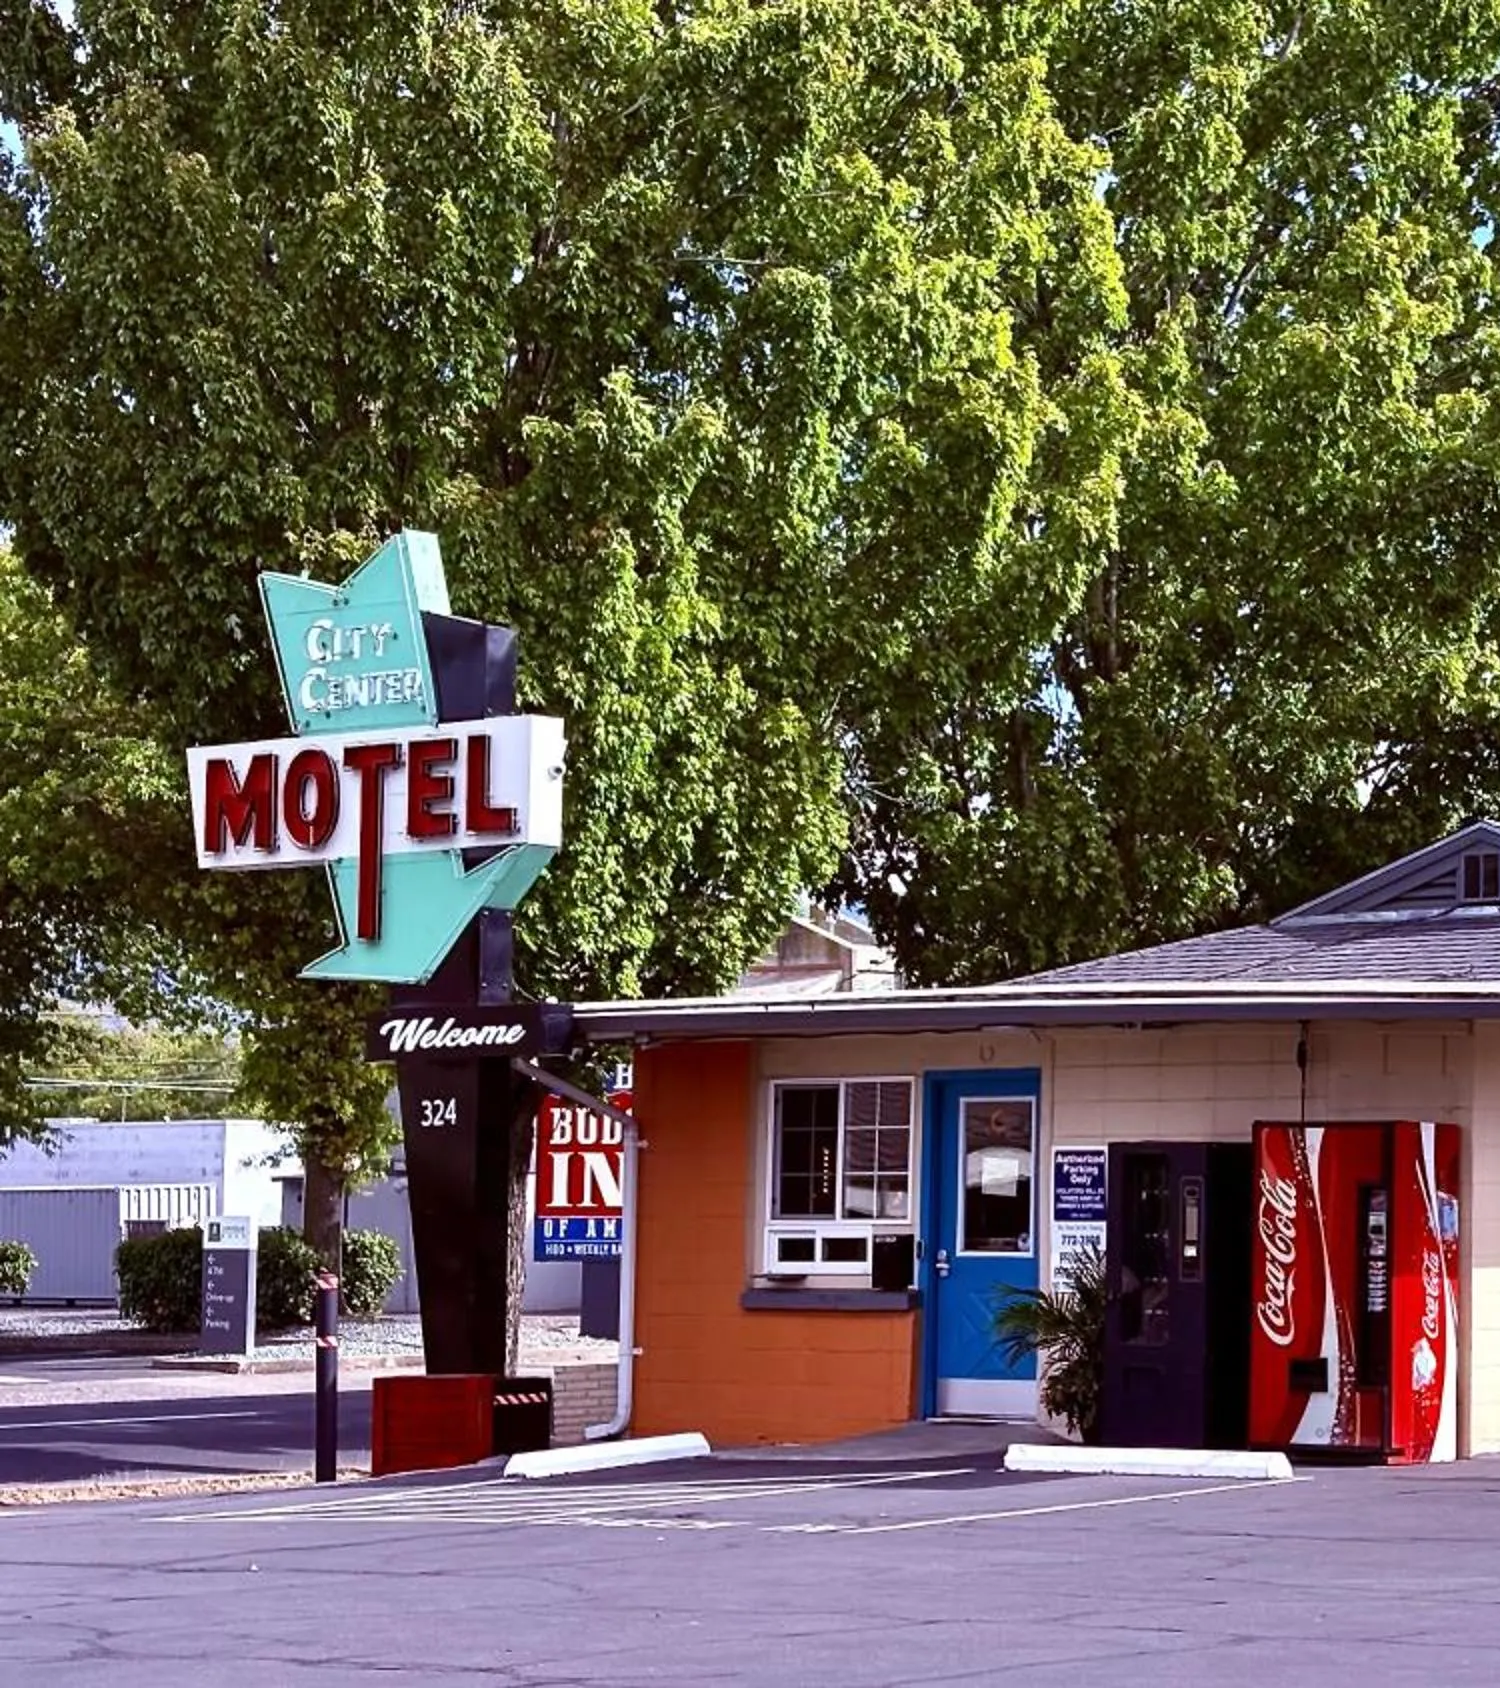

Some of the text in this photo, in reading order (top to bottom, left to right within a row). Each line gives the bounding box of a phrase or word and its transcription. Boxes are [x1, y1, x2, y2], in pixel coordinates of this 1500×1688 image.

[305, 619, 393, 664] CITY
[301, 668, 422, 712] CENTER
[204, 735, 520, 942] MOTEL
[379, 1017, 526, 1052] Welcome
[420, 1098, 457, 1127] 324
[550, 1107, 623, 1145] BUD
[545, 1152, 625, 1207] IN
[1063, 1164, 1099, 1176] Parking
[1070, 1174, 1092, 1186] Only
[543, 1219, 617, 1238] OF AM
